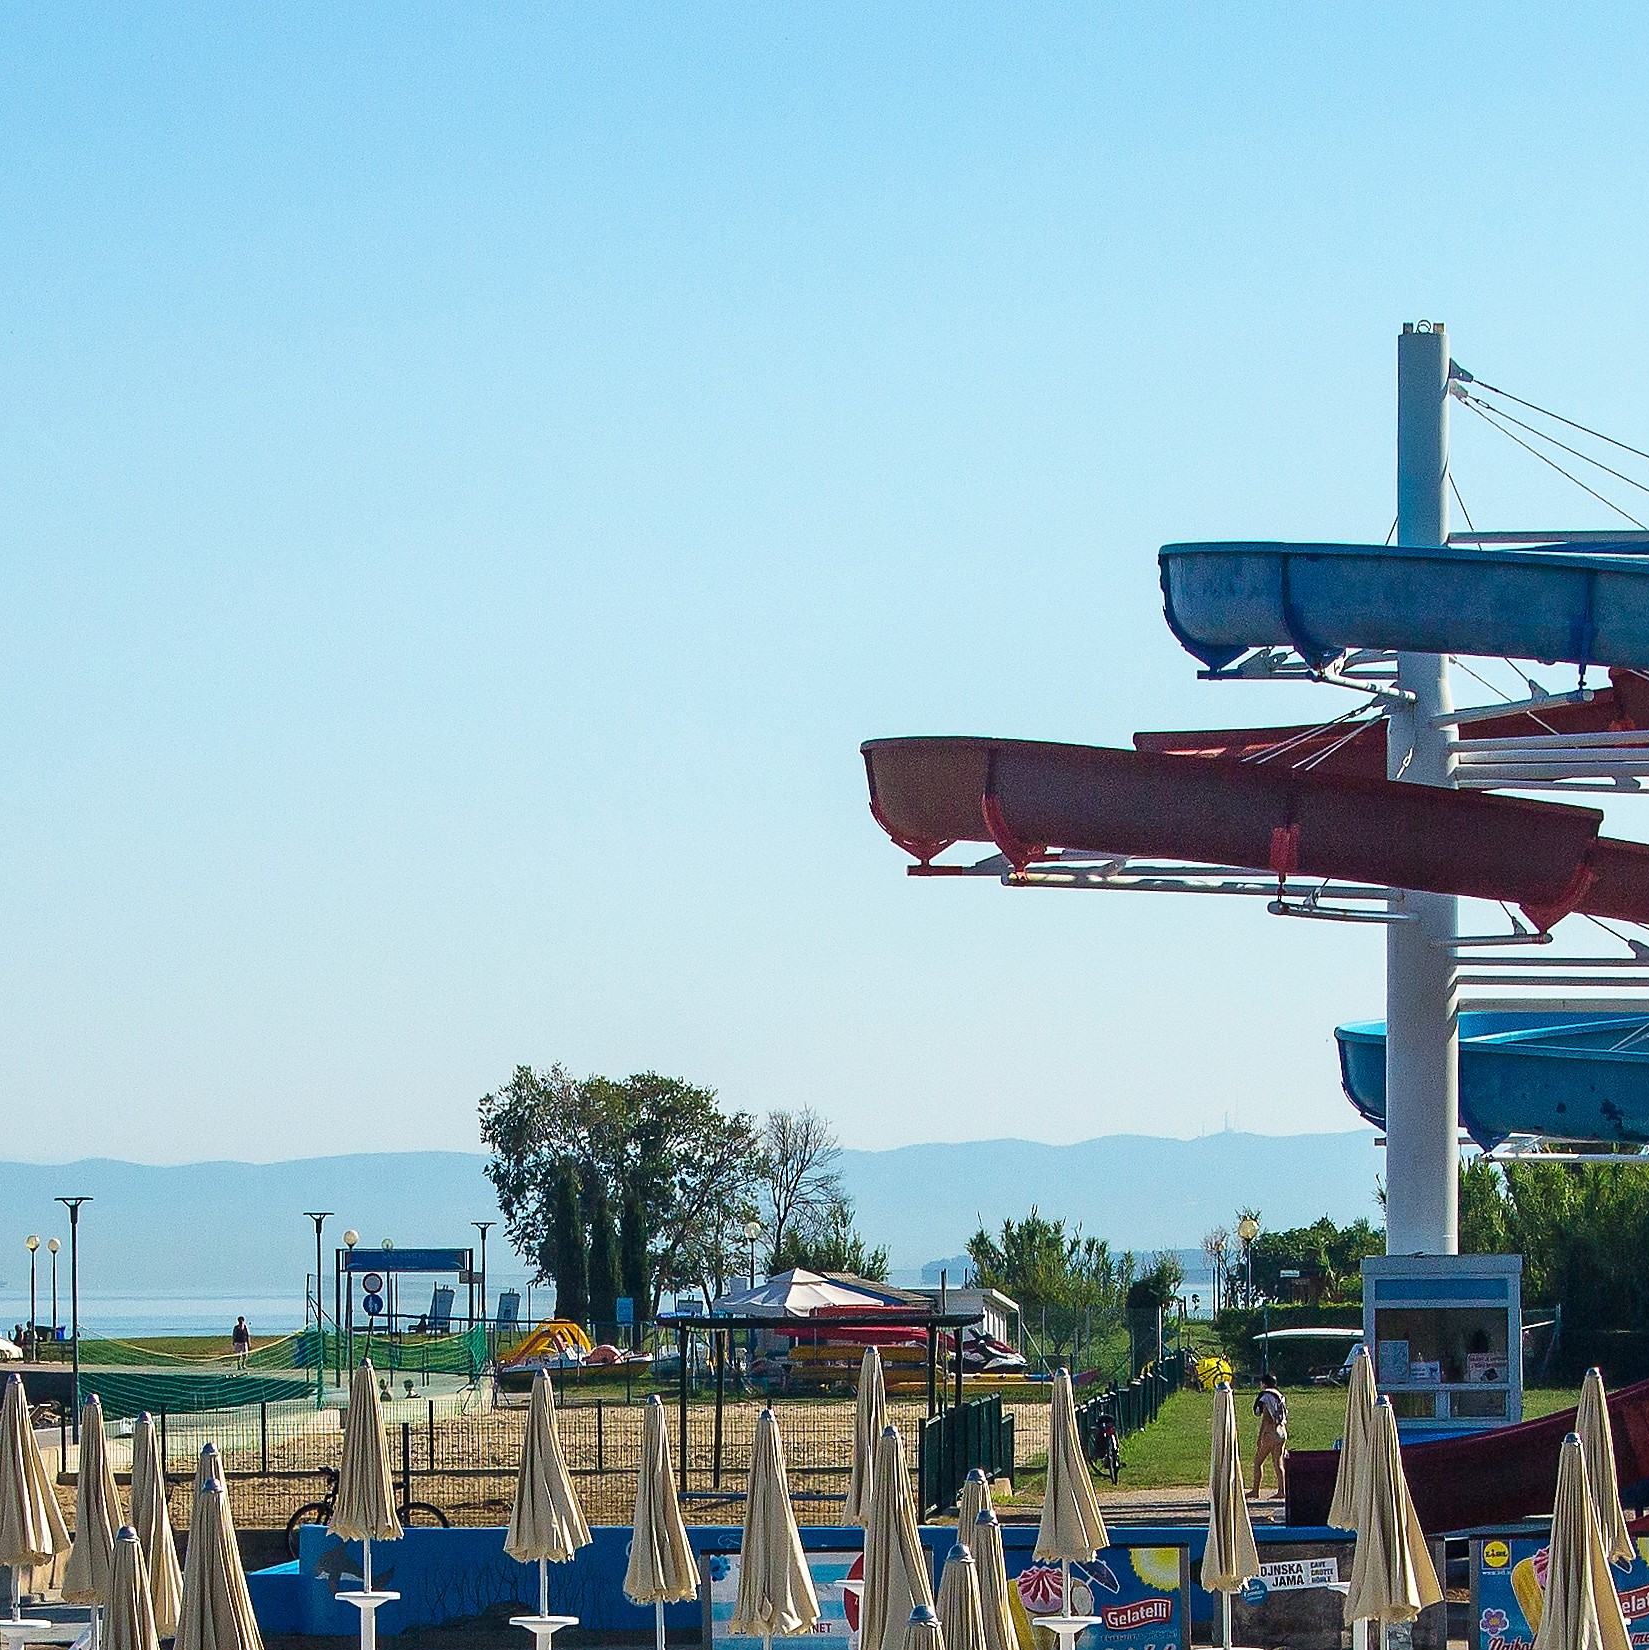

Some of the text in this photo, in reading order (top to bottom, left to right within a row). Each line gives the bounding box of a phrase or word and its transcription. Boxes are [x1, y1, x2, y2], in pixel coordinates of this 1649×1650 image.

[1260, 1563, 1304, 1577] OJNSKA
[1272, 1574, 1305, 1587] JAMA
[1108, 1602, 1167, 1627] Gelatelli
